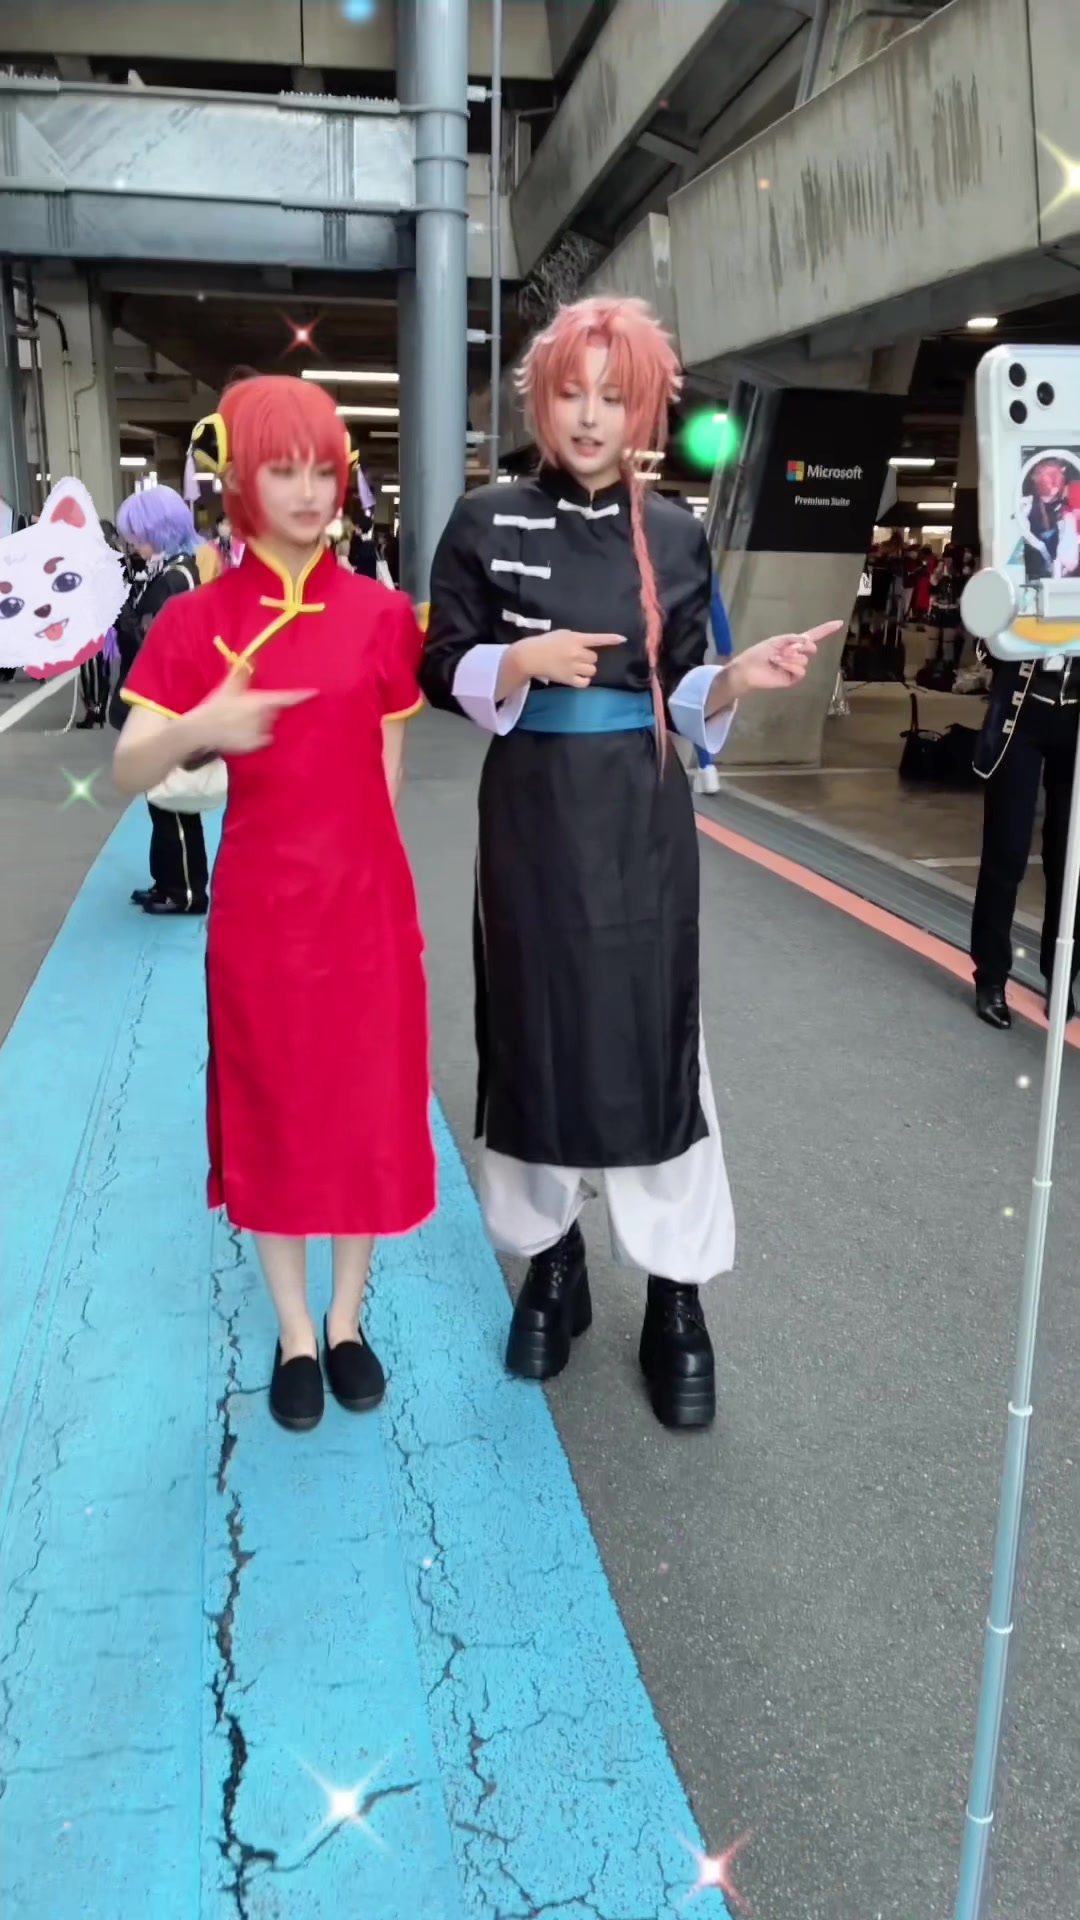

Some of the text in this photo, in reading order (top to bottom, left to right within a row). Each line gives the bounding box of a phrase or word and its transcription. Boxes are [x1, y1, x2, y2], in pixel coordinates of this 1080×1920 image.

[807, 464, 863, 480] Microsoft
[794, 496, 851, 507] Premium Suite
